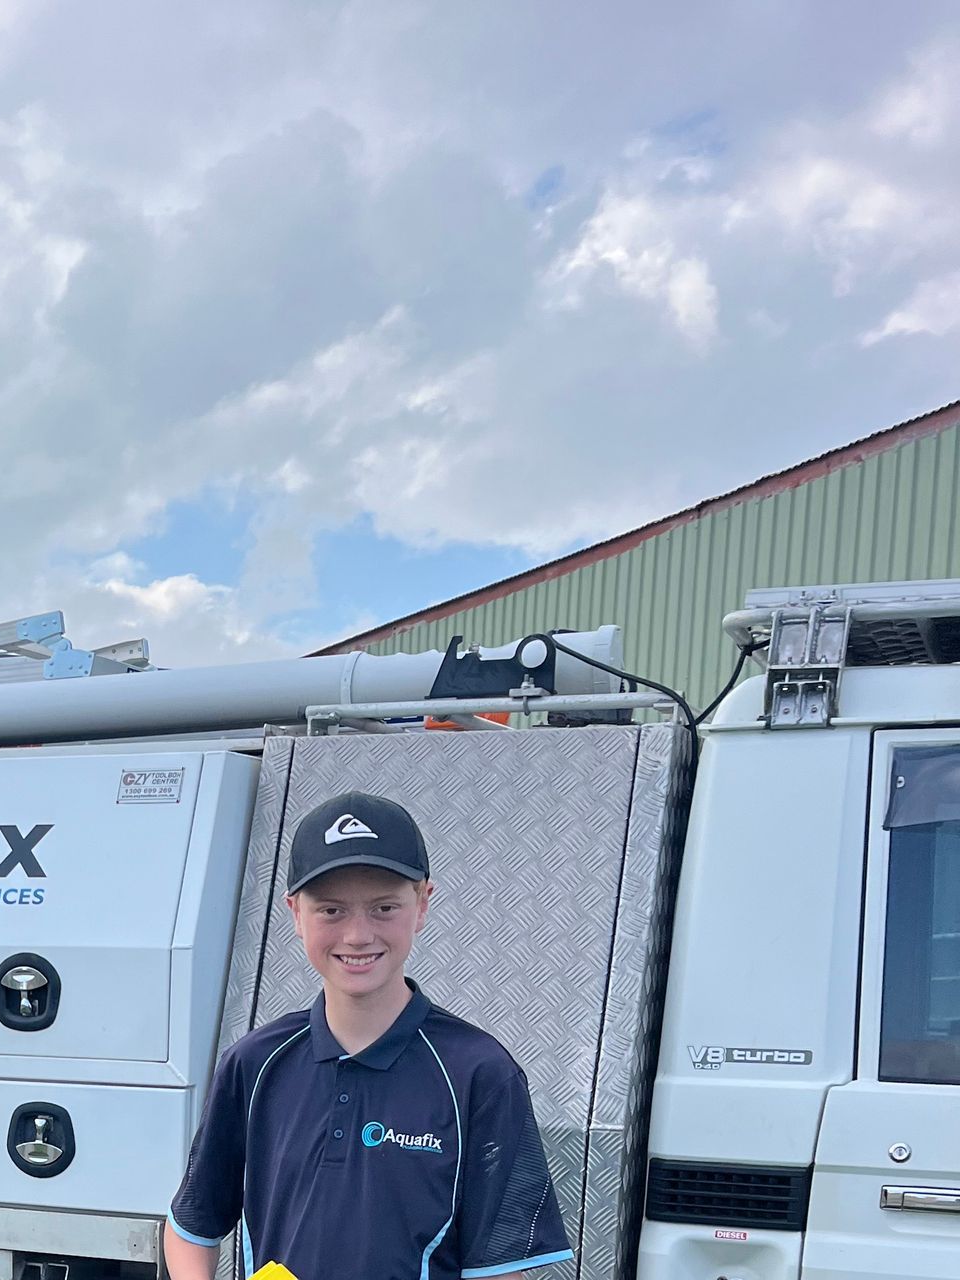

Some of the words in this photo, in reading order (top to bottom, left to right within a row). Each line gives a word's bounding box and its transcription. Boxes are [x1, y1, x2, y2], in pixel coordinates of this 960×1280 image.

[687, 1046, 725, 1063] V8
[732, 1050, 806, 1063] turbo
[383, 1128, 442, 1150] Aquafix
[716, 1231, 746, 1240] DIESEL
